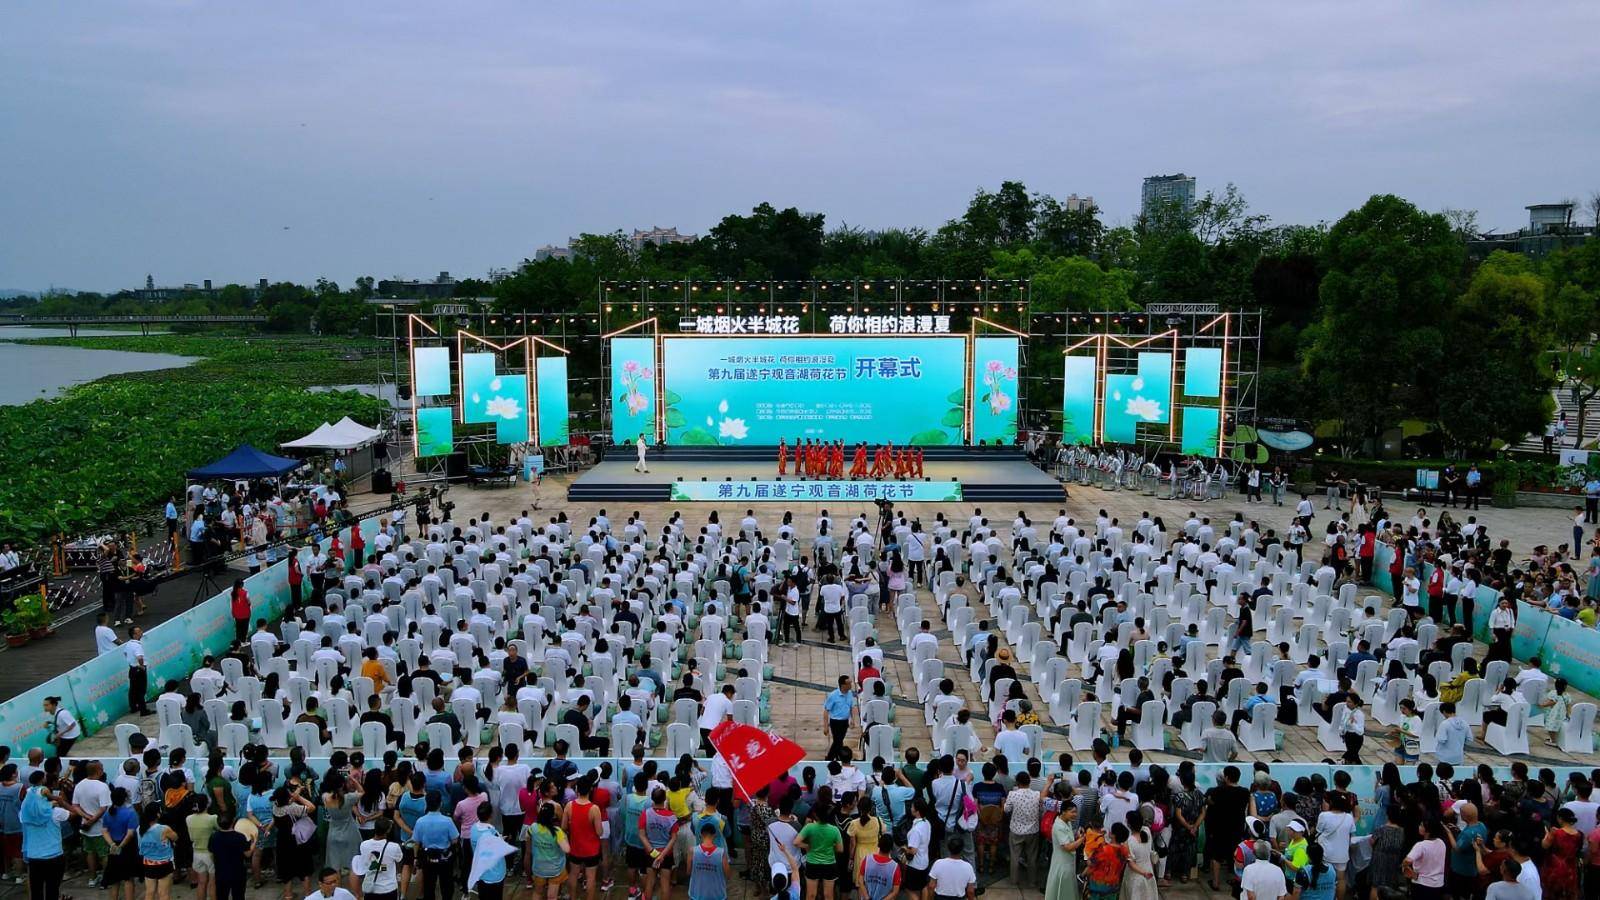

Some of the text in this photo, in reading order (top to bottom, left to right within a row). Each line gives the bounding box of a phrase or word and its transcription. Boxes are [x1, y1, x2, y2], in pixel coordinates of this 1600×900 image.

[679, 316, 951, 334] 一城烟火半城花 荷你相约浪漫夏
[708, 368, 848, 380] 第九届遂宁观音湖荷花节
[855, 357, 921, 379] 开幕式
[718, 483, 915, 498] 第九届遂宁观音湖荷花节
